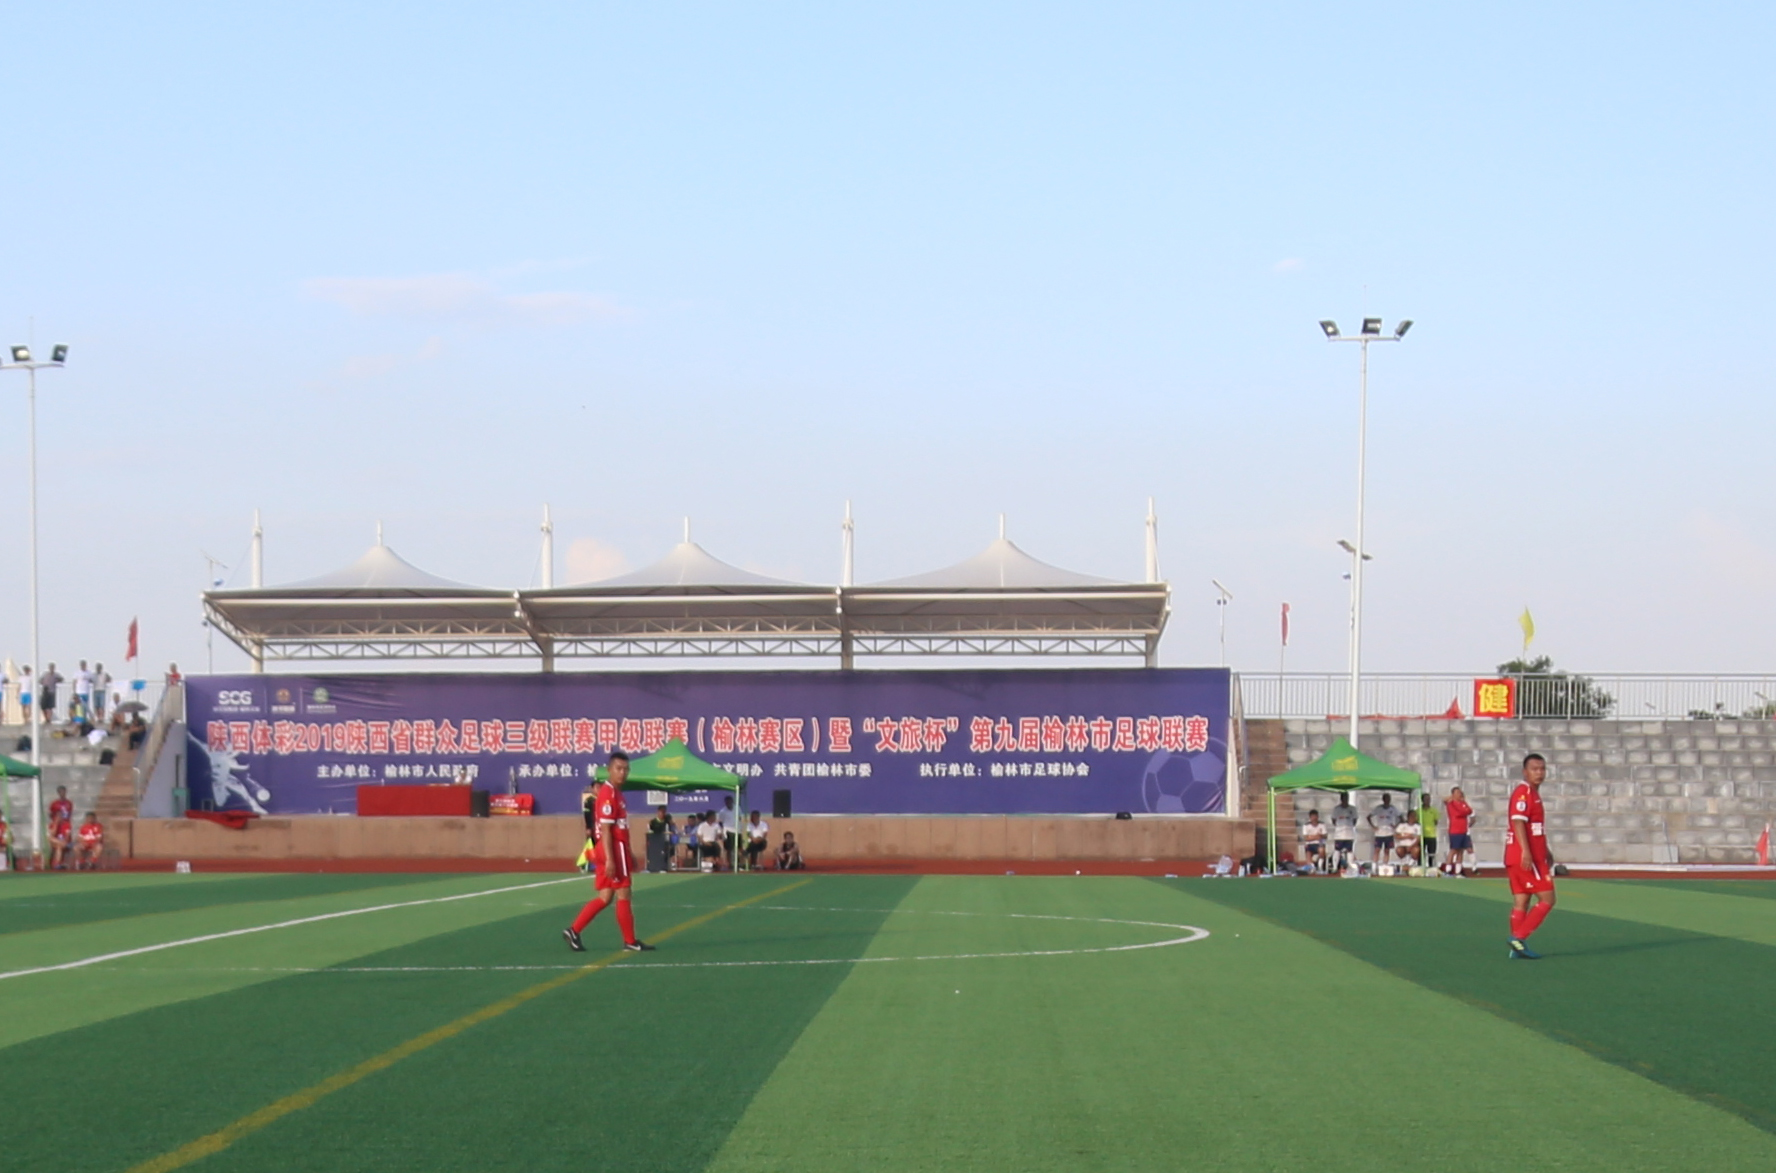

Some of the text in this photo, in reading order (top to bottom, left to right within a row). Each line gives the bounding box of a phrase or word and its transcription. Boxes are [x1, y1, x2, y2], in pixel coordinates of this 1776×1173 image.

[218, 690, 252, 705] SCG
[1479, 683, 1508, 713] 健
[920, 762, 1091, 777] 执行单位：榆林市足球协会
